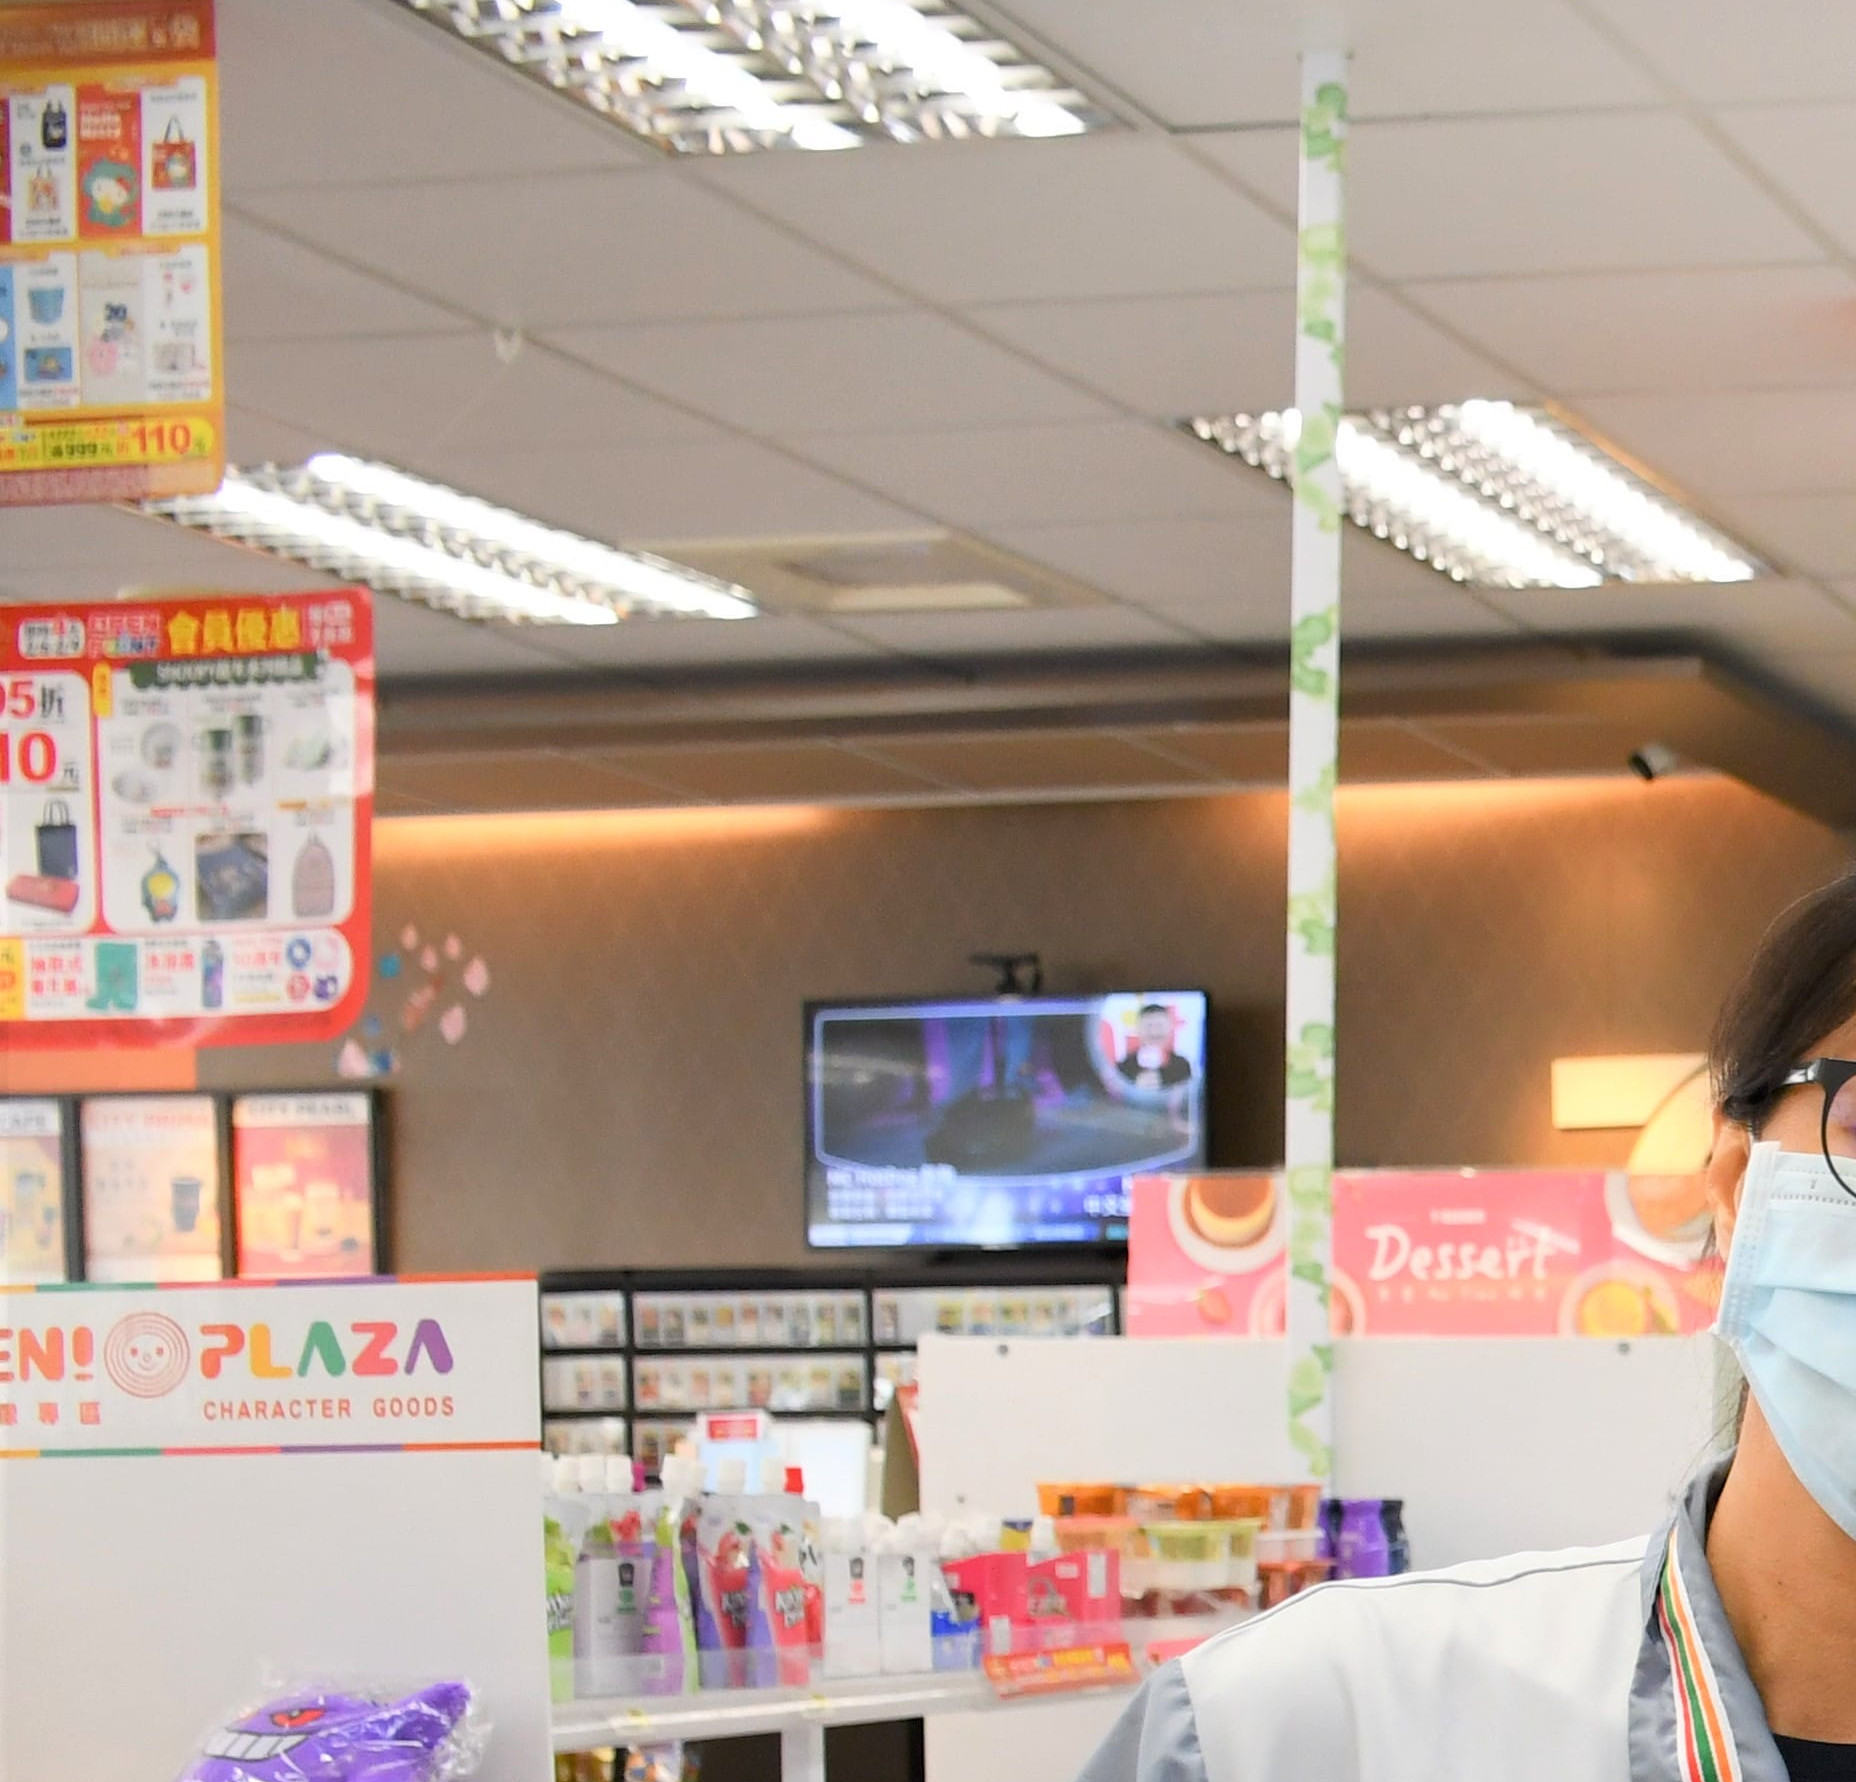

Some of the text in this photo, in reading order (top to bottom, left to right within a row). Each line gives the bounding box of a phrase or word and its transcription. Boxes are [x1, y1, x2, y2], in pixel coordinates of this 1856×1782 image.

[168, 605, 301, 656] 會員優惠
[1366, 1223, 1555, 1281] Dessert
[200, 1318, 454, 1378] PLAZA
[204, 1396, 455, 1420] CHARACTER GOODS
